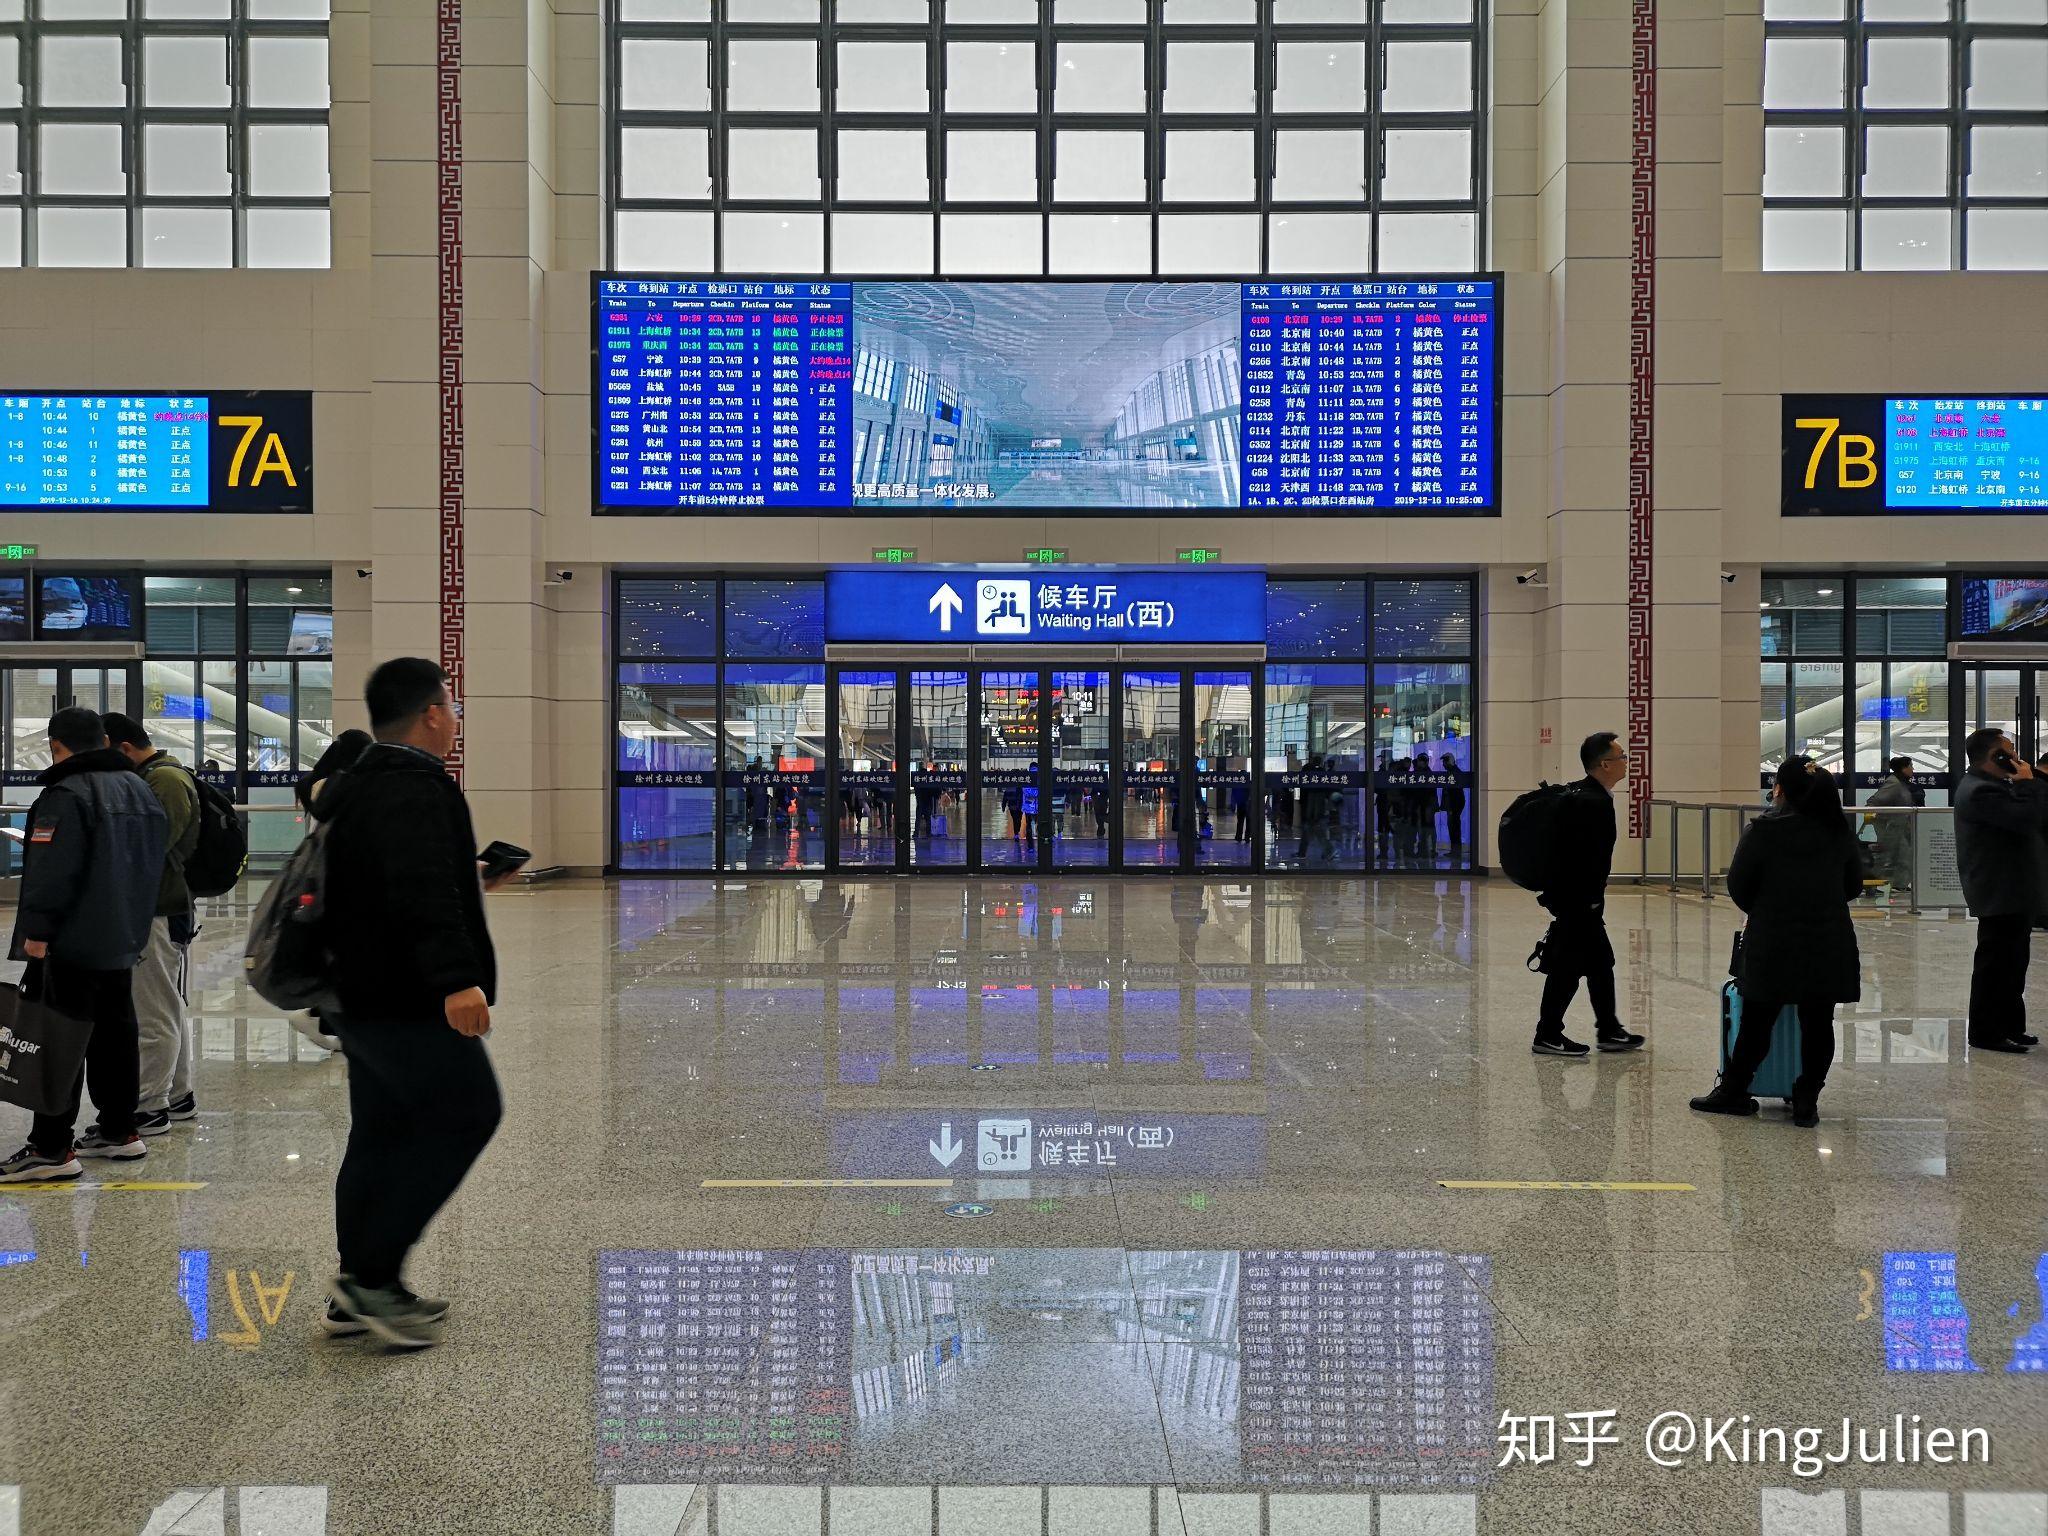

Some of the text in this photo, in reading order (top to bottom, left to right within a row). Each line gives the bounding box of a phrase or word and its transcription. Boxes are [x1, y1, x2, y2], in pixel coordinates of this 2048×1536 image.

[607, 282, 832, 294] 车次 终到站 开点 检票口 站台 地标 状态
[1248, 283, 1475, 296] 车次 终到站 开点 检票口 站台 地标 状态
[1249, 327, 1443, 338] G120 北京南 10:40 橘黄色
[1249, 341, 1443, 352] G110 北京南 10:44 橘黄色
[1281, 356, 1345, 366] 北京南 10:48
[1286, 370, 1305, 380] 青岛
[1318, 370, 1345, 379] 10:53
[1412, 369, 1442, 379] 橘黄色
[1249, 384, 1345, 394] G112 北京南 11:07
[41, 398, 66, 409] 开点
[81, 398, 107, 409] 站台
[120, 398, 146, 409] 地标
[168, 398, 194, 409] 状态
[1249, 397, 1442, 408] G258 青岛 11:11 橘黄色
[1895, 400, 1918, 410] 车次
[1977, 400, 2005, 410] 终到站
[8, 412, 24, 421] 1-8
[42, 412, 68, 421] 10:44
[88, 412, 99, 421] 10
[117, 411, 148, 422] 橘黄色
[1246, 412, 1305, 422] G1232 丹东
[42, 426, 68, 435] 10:44
[116, 425, 148, 436] 橘黄色
[170, 425, 192, 436] 正点
[1249, 426, 1344, 436] G114 北京南 11:22
[8, 439, 192, 450] 1-8 10:46 11 橘黄色 正点
[1249, 439, 1344, 450] G352 北京南 11:29
[1893, 441, 2010, 452] G1911 西安北 上海虹桥
[218, 416, 298, 487] 7A
[1795, 418, 1878, 489] 7B
[8, 453, 191, 464] 1-8 10:48 2 橘黄色 正点
[1246, 453, 1344, 463] G1224 沈阳北 11:33
[1893, 456, 1920, 466] G1975
[1929, 456, 1968, 466] 上海虹桥
[2018, 456, 2041, 466] 9-16
[42, 467, 191, 478] 10:53 8 橘黄色 正点
[1280, 467, 1344, 477] 北京南 11:37
[1898, 469, 2040, 480] G57 北京南 宁波 9-16
[5, 482, 190, 493] 9-16 10:53 5 橘黄色 正点
[1248, 482, 1344, 493] G212 天津西 11:48
[1895, 484, 2040, 495] G120 上海虹桥 北京南 9-16
[1038, 584, 1117, 609] 候车厅
[1038, 613, 1123, 631] Waiting Hall
